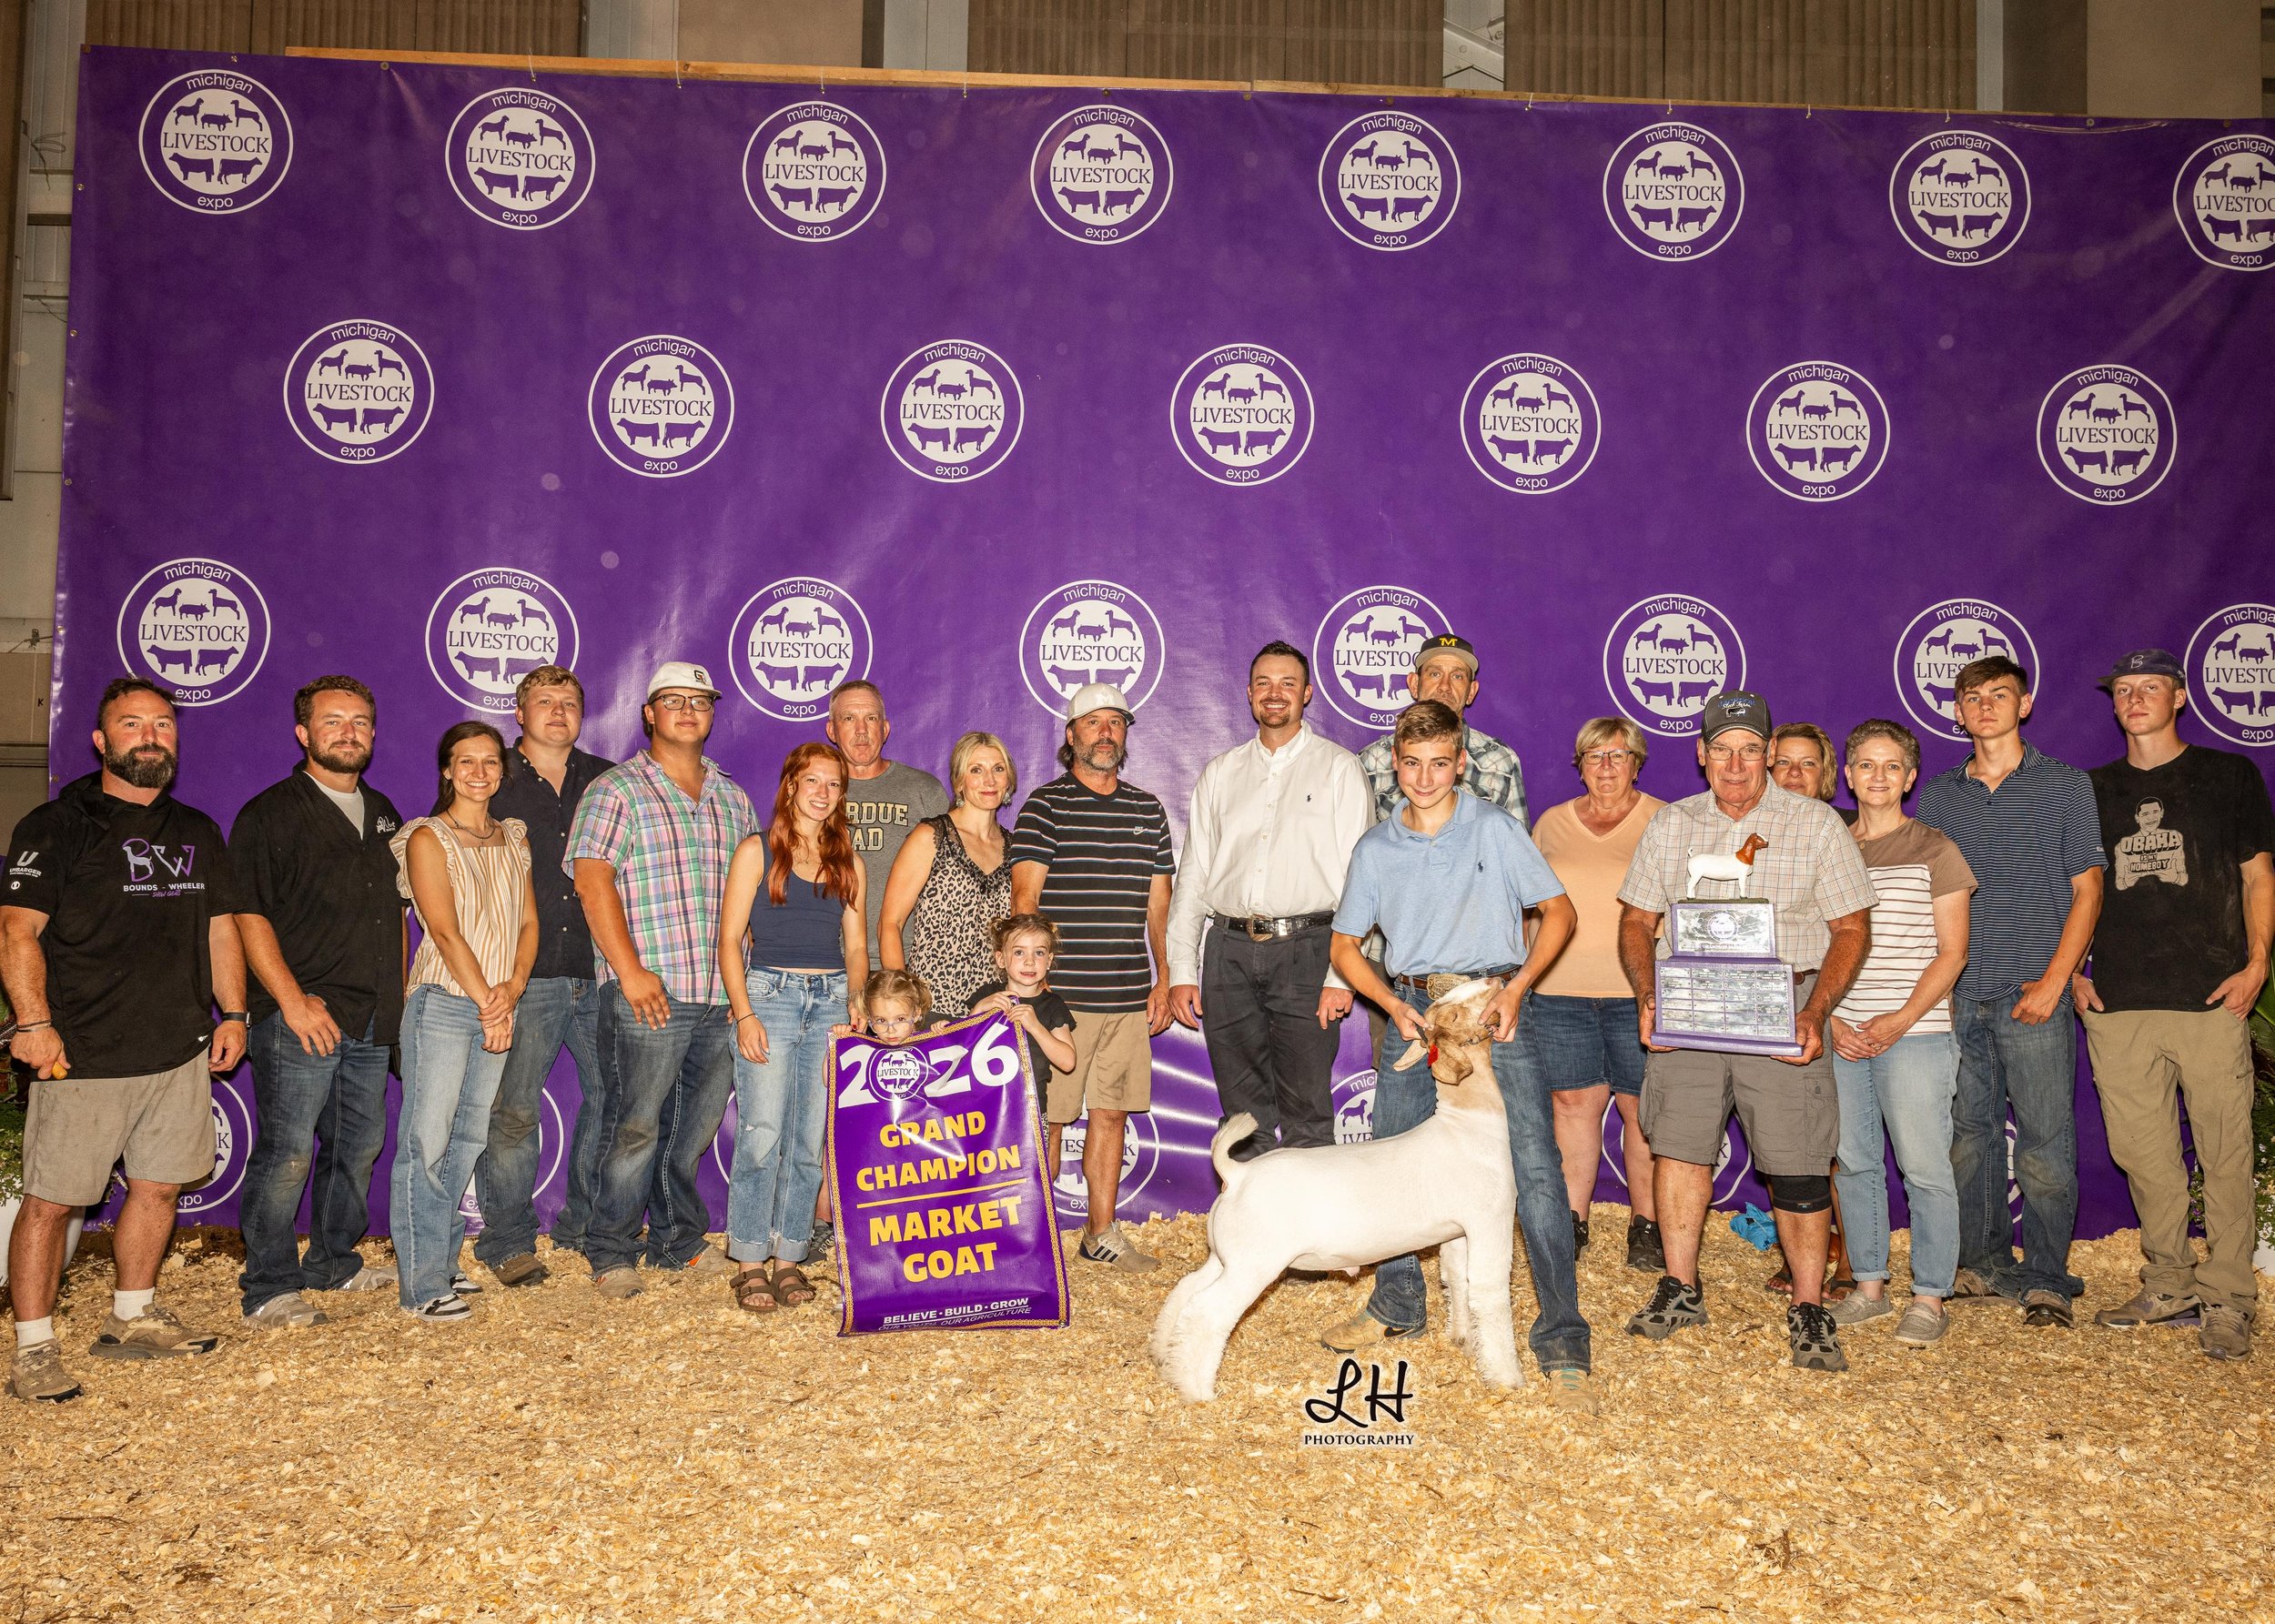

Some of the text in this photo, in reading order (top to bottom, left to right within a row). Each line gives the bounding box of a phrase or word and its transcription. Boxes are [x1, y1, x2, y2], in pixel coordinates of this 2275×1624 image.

[187, 74, 253, 94] michigan
[491, 92, 556, 113] michigan
[787, 105, 848, 124] michigan
[1074, 108, 1135, 127] michigan
[1361, 115, 1421, 135] michigan
[163, 132, 268, 153] LIVESTOCK
[1645, 126, 1705, 145] michigan
[1930, 134, 1991, 151] michigan
[2213, 137, 2275, 156] michigan
[469, 149, 573, 171] LIVESTOCK
[764, 164, 864, 182] LIVESTOCK
[1053, 166, 1151, 184] LIVESTOCK
[1340, 174, 1439, 191] LIVESTOCK
[1625, 185, 1723, 201] LIVESTOCK
[1911, 191, 2008, 207] LIVESTOCK
[197, 197, 233, 210] expo
[2196, 195, 2275, 213] LIVESTOC
[502, 211, 538, 226] expo
[797, 225, 831, 238] expo
[1085, 227, 1118, 241] expo
[1374, 235, 1407, 247] expo
[1658, 245, 1692, 257] expo
[1946, 250, 1979, 262] expo
[2230, 255, 2262, 267] expo
[331, 323, 396, 343] michigan
[633, 338, 695, 358] michigan
[925, 343, 986, 362] michigan
[1214, 348, 1275, 366] michigan
[1502, 357, 1562, 377] michigan
[1788, 365, 1849, 383] michigan
[2078, 368, 2138, 387] michigan
[308, 383, 411, 402] LIVESTOCK
[612, 398, 712, 416] LIVESTOCK
[903, 403, 1002, 420] LIVESTOCK
[1192, 407, 1292, 424] LIVESTOCK
[1482, 415, 1579, 434] LIVESTOCK
[1769, 424, 1867, 440] LIVESTOCK
[2058, 427, 2156, 444] LIVESTOCK
[340, 447, 376, 460] expo
[644, 460, 678, 474] expo
[935, 466, 968, 479] expo
[1226, 469, 1259, 482] expo
[1515, 477, 1548, 490] expo
[1802, 485, 1835, 498] expo
[2094, 488, 2126, 501] expo
[164, 562, 231, 581] michigan
[472, 571, 539, 592] michigan
[773, 580, 834, 600] michigan
[1064, 584, 1126, 602] michigan
[1357, 590, 1419, 609] michigan
[1645, 598, 1705, 617] michigan
[1936, 602, 1997, 621] michigan
[2223, 608, 2275, 625] michiga
[141, 624, 246, 641] LIVESTOCK
[449, 631, 556, 651] LIVESTOCK
[750, 641, 850, 659] LIVESTOCK
[1440, 637, 1458, 647] M
[1042, 644, 1142, 661] LIVESTOCK
[1625, 658, 1724, 675] LIVESTOCK
[2206, 667, 2275, 684] LIVESTO
[175, 689, 211, 702] expo
[784, 704, 816, 718] expo
[1660, 720, 1694, 732] expo
[2242, 729, 2273, 742] expo
[845, 802, 908, 826] RDUE
[2130, 859, 2169, 872] HOMEBOY
[879, 1111, 986, 1148] GRAND
[856, 1145, 1021, 1191] CHAMPION
[178, 1195, 202, 1209] xpo
[1070, 1198, 1087, 1209] ex
[869, 1195, 1022, 1246] MARKET
[903, 1242, 997, 1282] GOAT
[883, 1297, 1029, 1324] BELIEVE BUILD GROW
[962, 1307, 1031, 1323] AGRICULTURE
